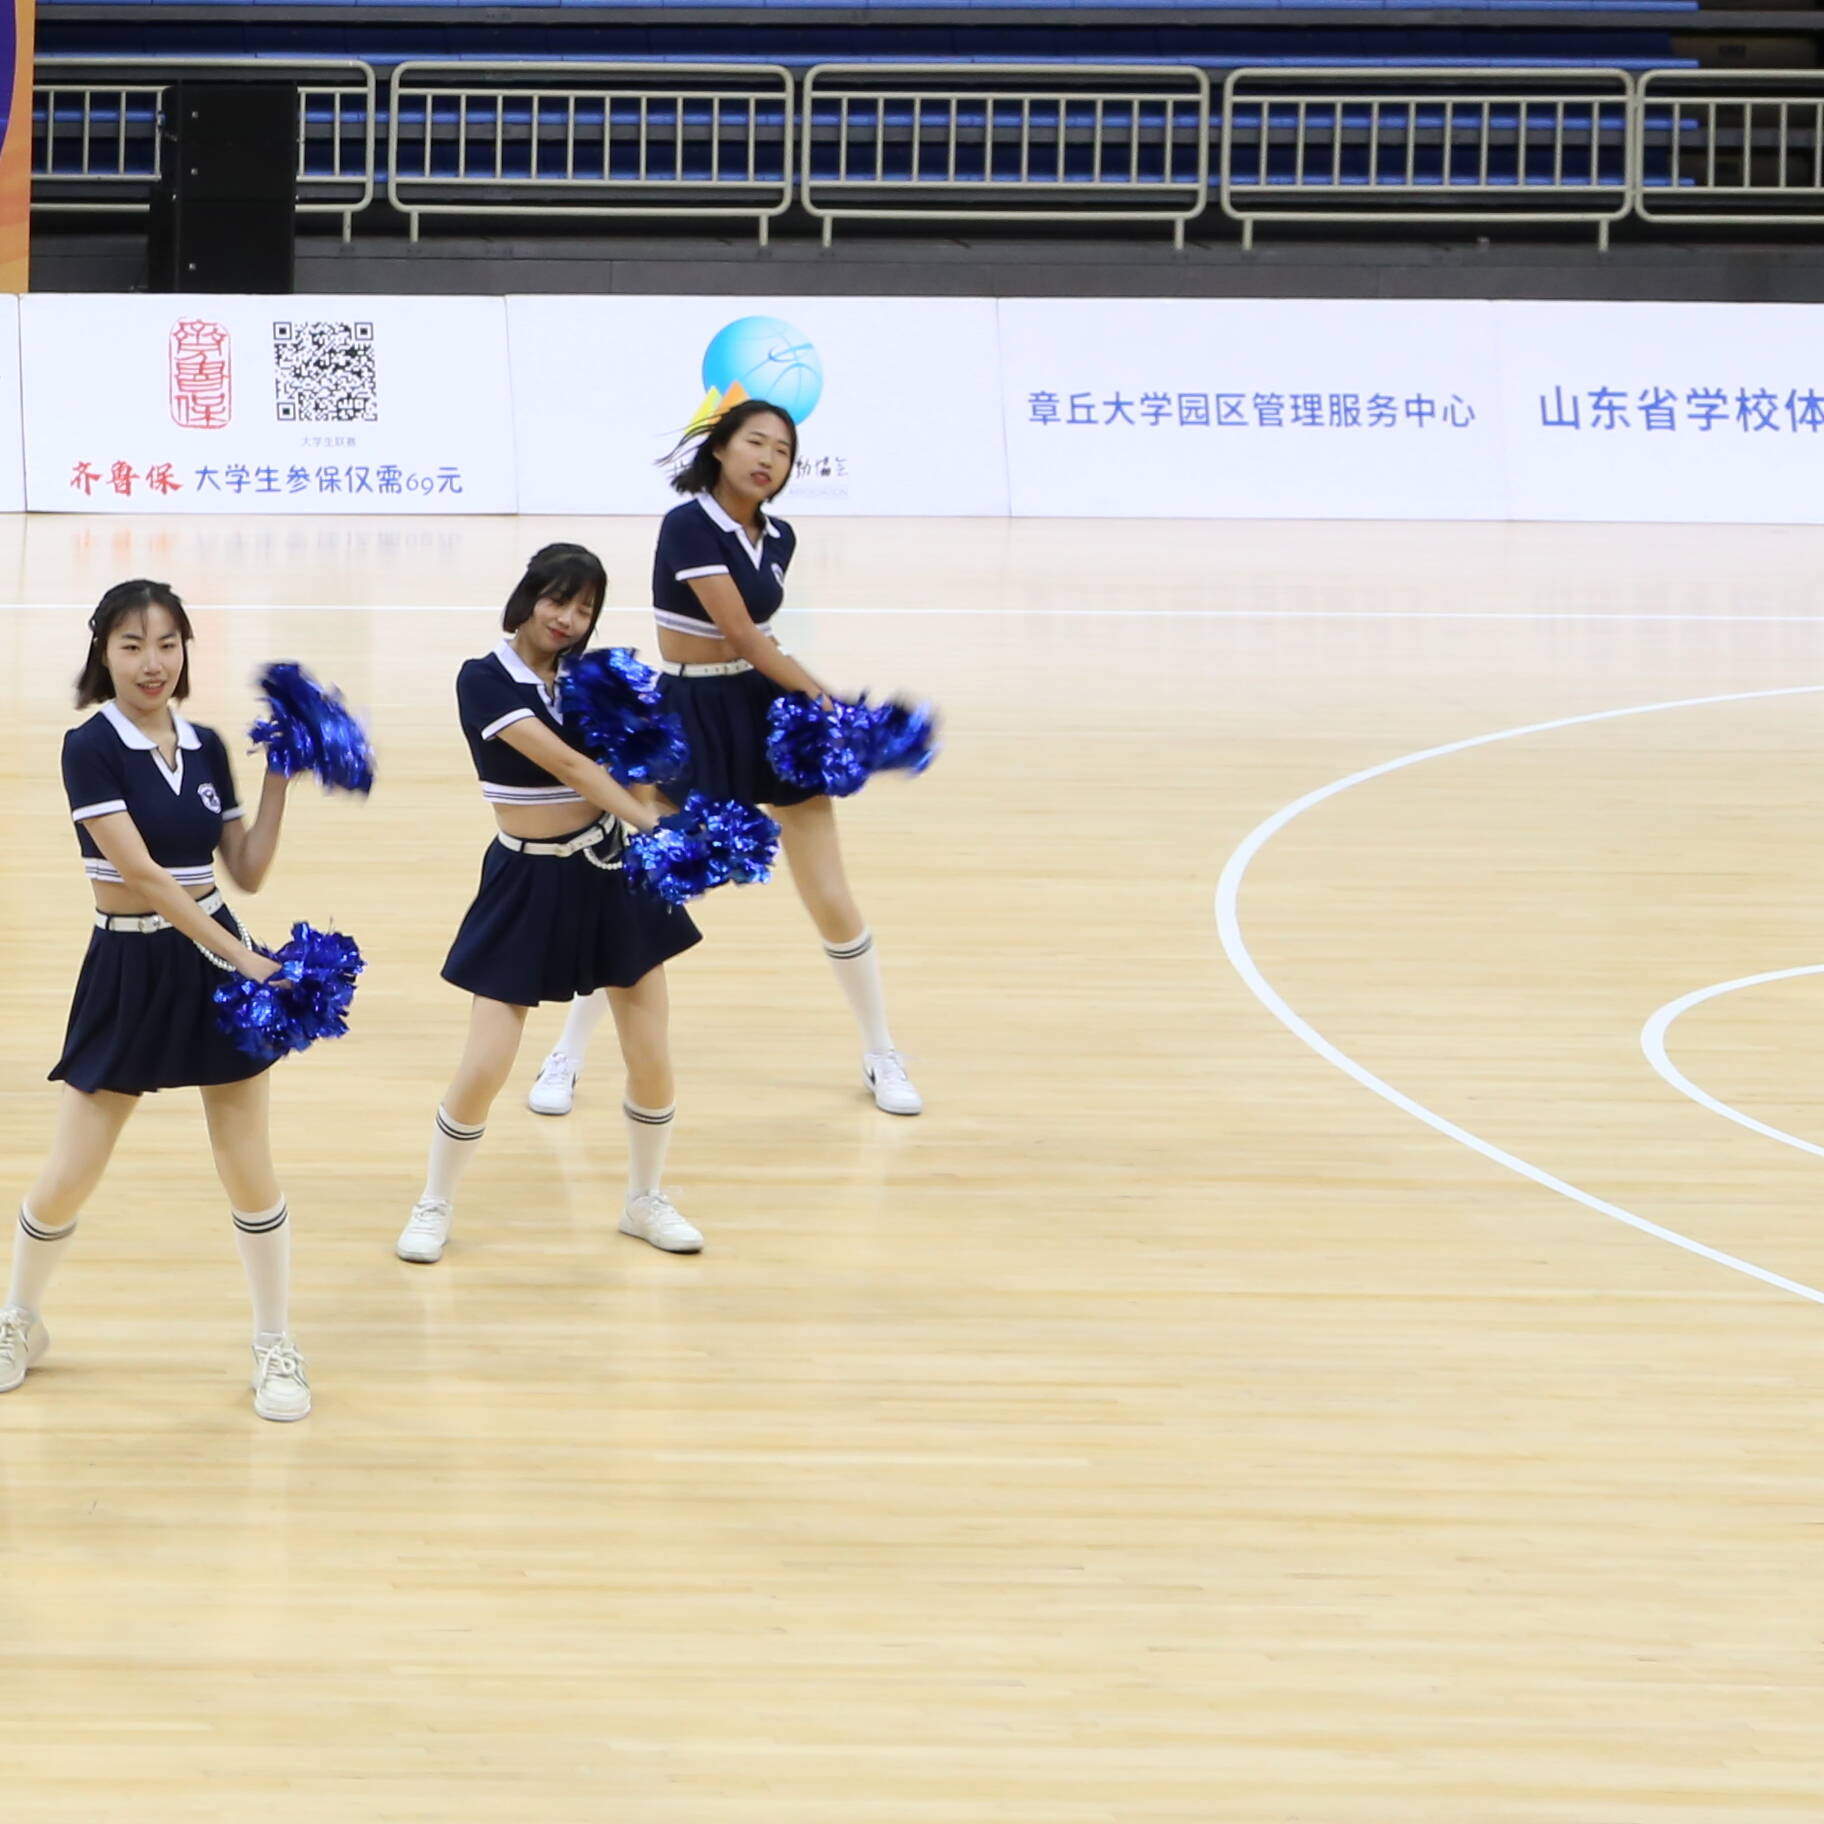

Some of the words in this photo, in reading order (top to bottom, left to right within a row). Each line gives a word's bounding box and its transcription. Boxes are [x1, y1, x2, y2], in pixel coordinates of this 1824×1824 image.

[1027, 389, 1477, 430] 章丘大学园区管理服务中心
[1539, 385, 1824, 435] 山东省学校体
[69, 459, 186, 497] 齐鲁保
[194, 464, 464, 496] 大学生参保仅需69元
